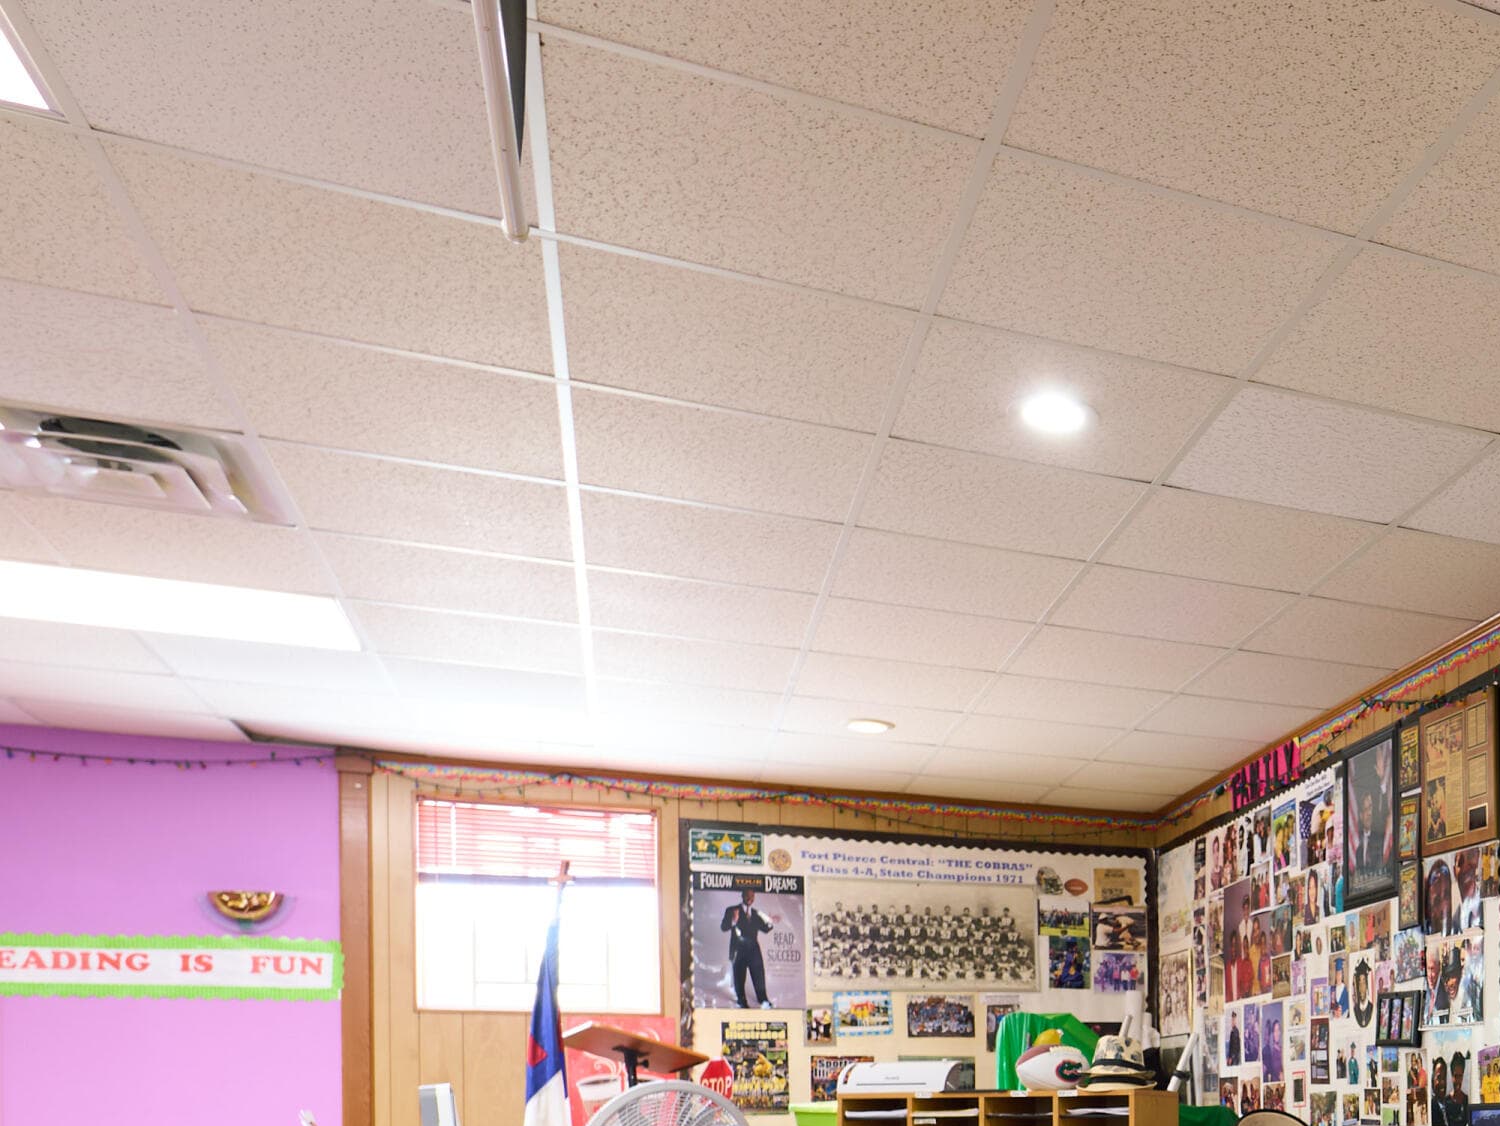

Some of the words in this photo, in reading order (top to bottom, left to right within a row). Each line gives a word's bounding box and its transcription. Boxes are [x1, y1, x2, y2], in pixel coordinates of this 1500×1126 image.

[1230, 739, 1295, 812] FAMILY
[800, 850, 829, 861] Fort
[832, 852, 877, 864] Pierce
[879, 855, 934, 867] Central:
[700, 872, 733, 889] FOLLOW
[765, 875, 798, 893] DREAMS
[811, 864, 849, 875] Class
[880, 868, 914, 879] State
[916, 870, 993, 883] Champions
[995, 874, 1024, 884] 1971
[773, 932, 795, 946] READ
[180, 954, 213, 972] IS
[251, 955, 323, 975] FUN
[767, 949, 801, 963] SUCCEED
[702, 1075, 732, 1096] STOP
